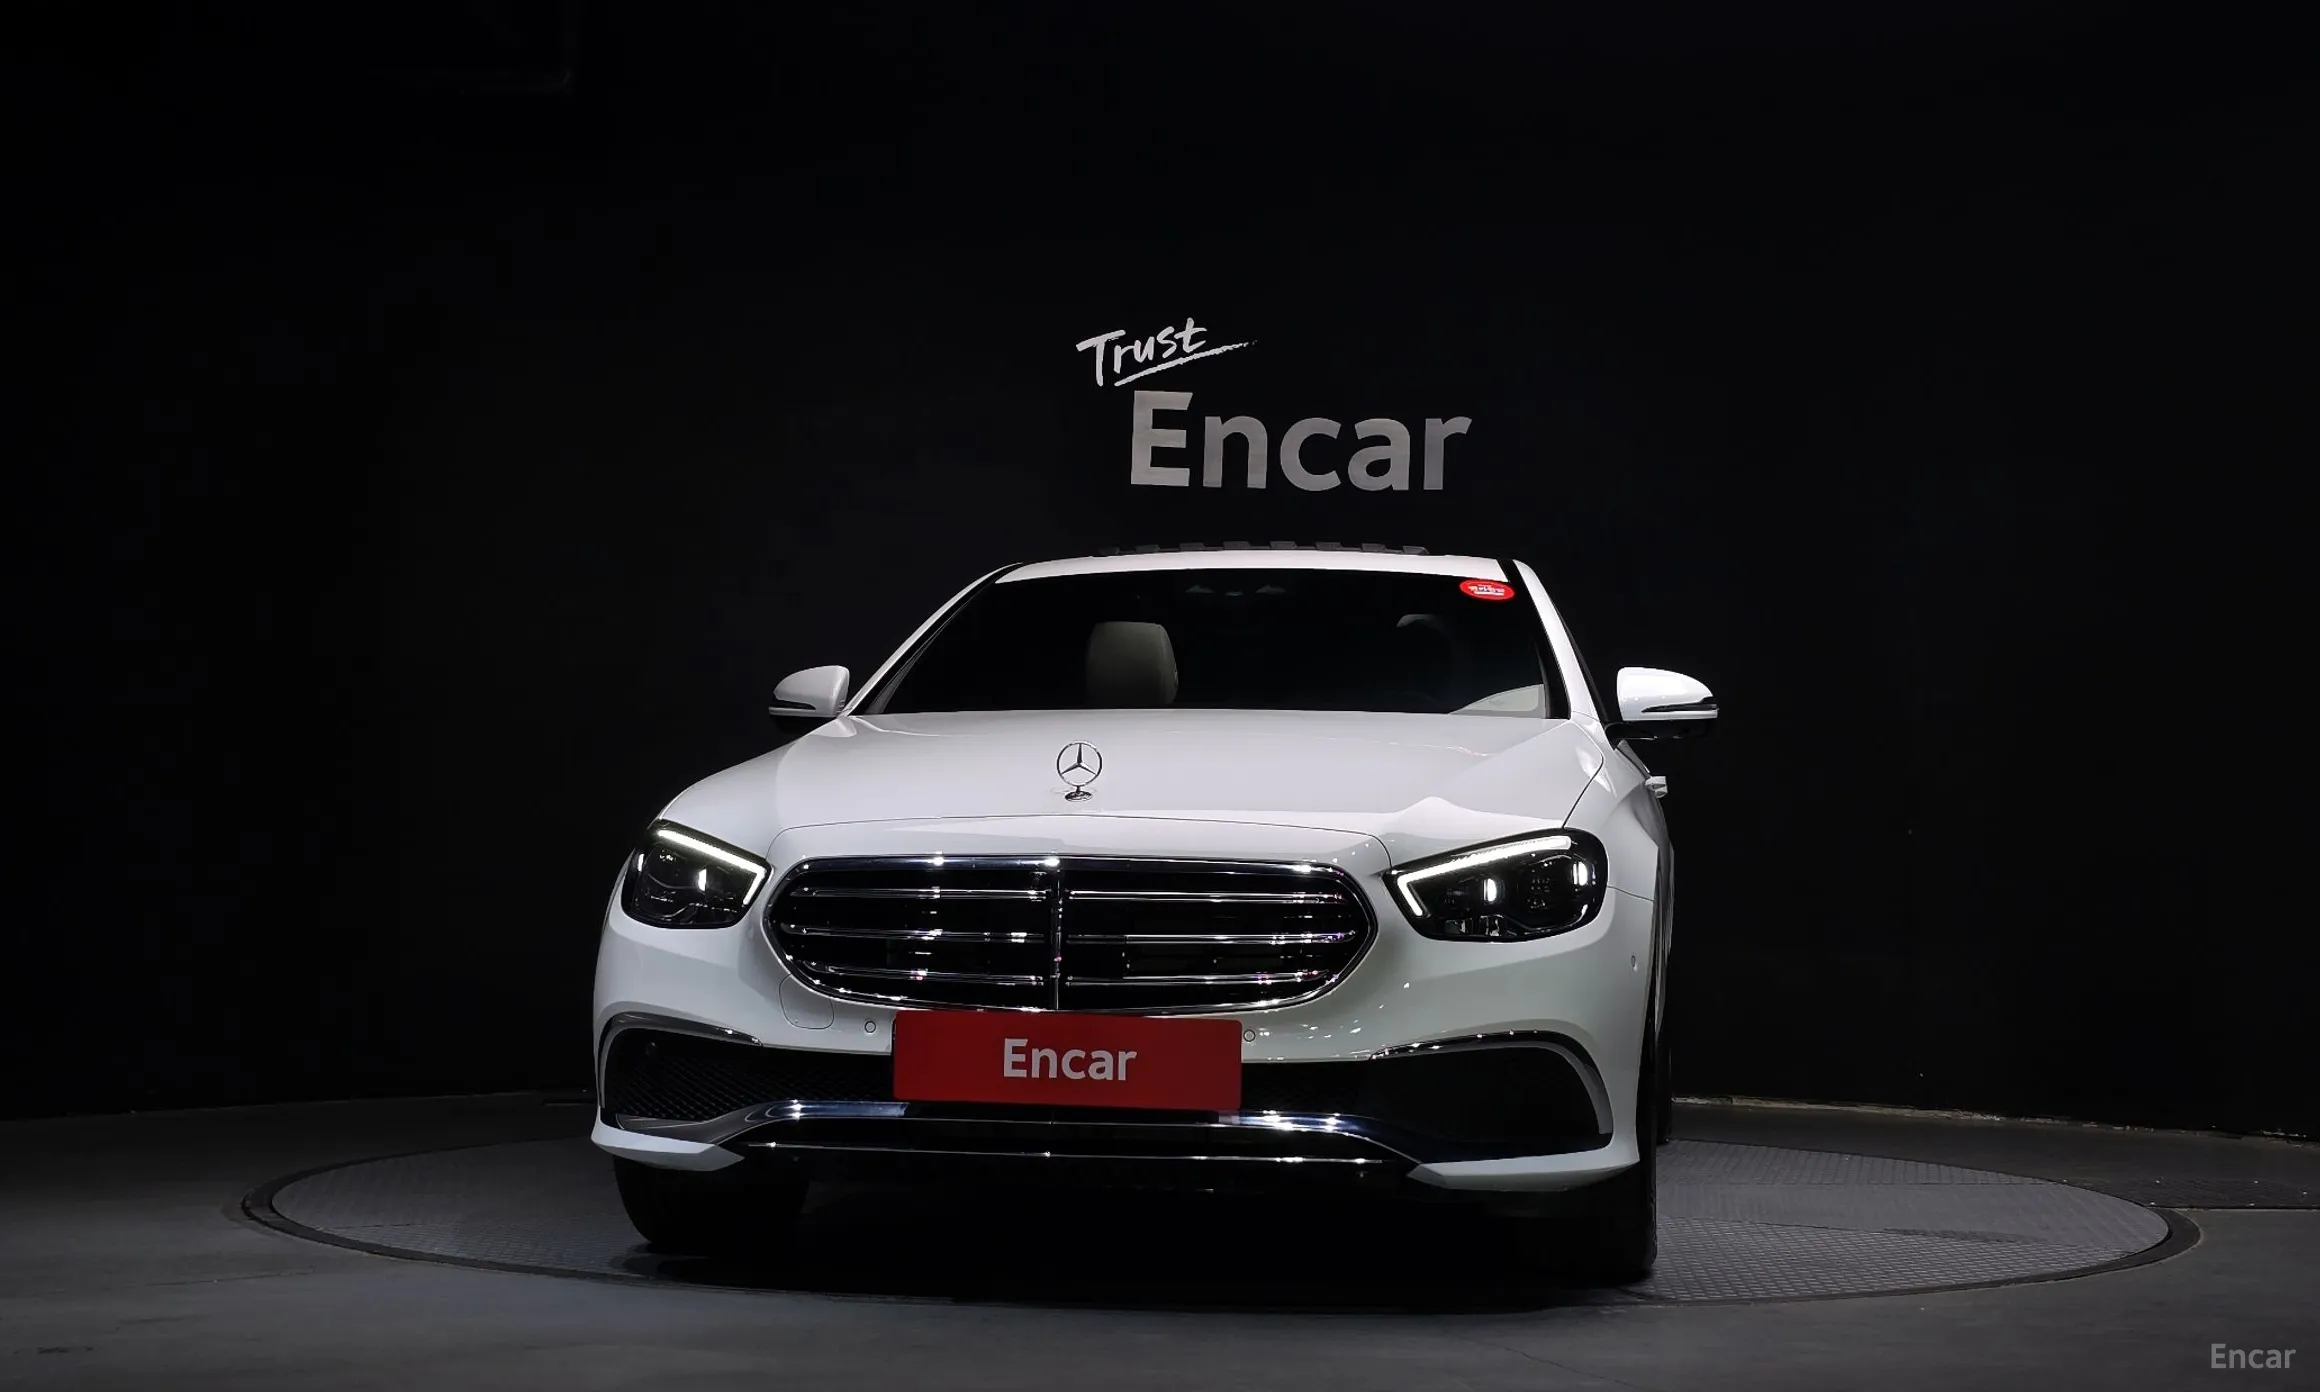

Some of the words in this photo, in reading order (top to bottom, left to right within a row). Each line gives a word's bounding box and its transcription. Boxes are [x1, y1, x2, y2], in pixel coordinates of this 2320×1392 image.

[1076, 317, 1207, 387] Trust
[1130, 389, 1473, 492] Encar
[1003, 1038, 1137, 1081] Encar
